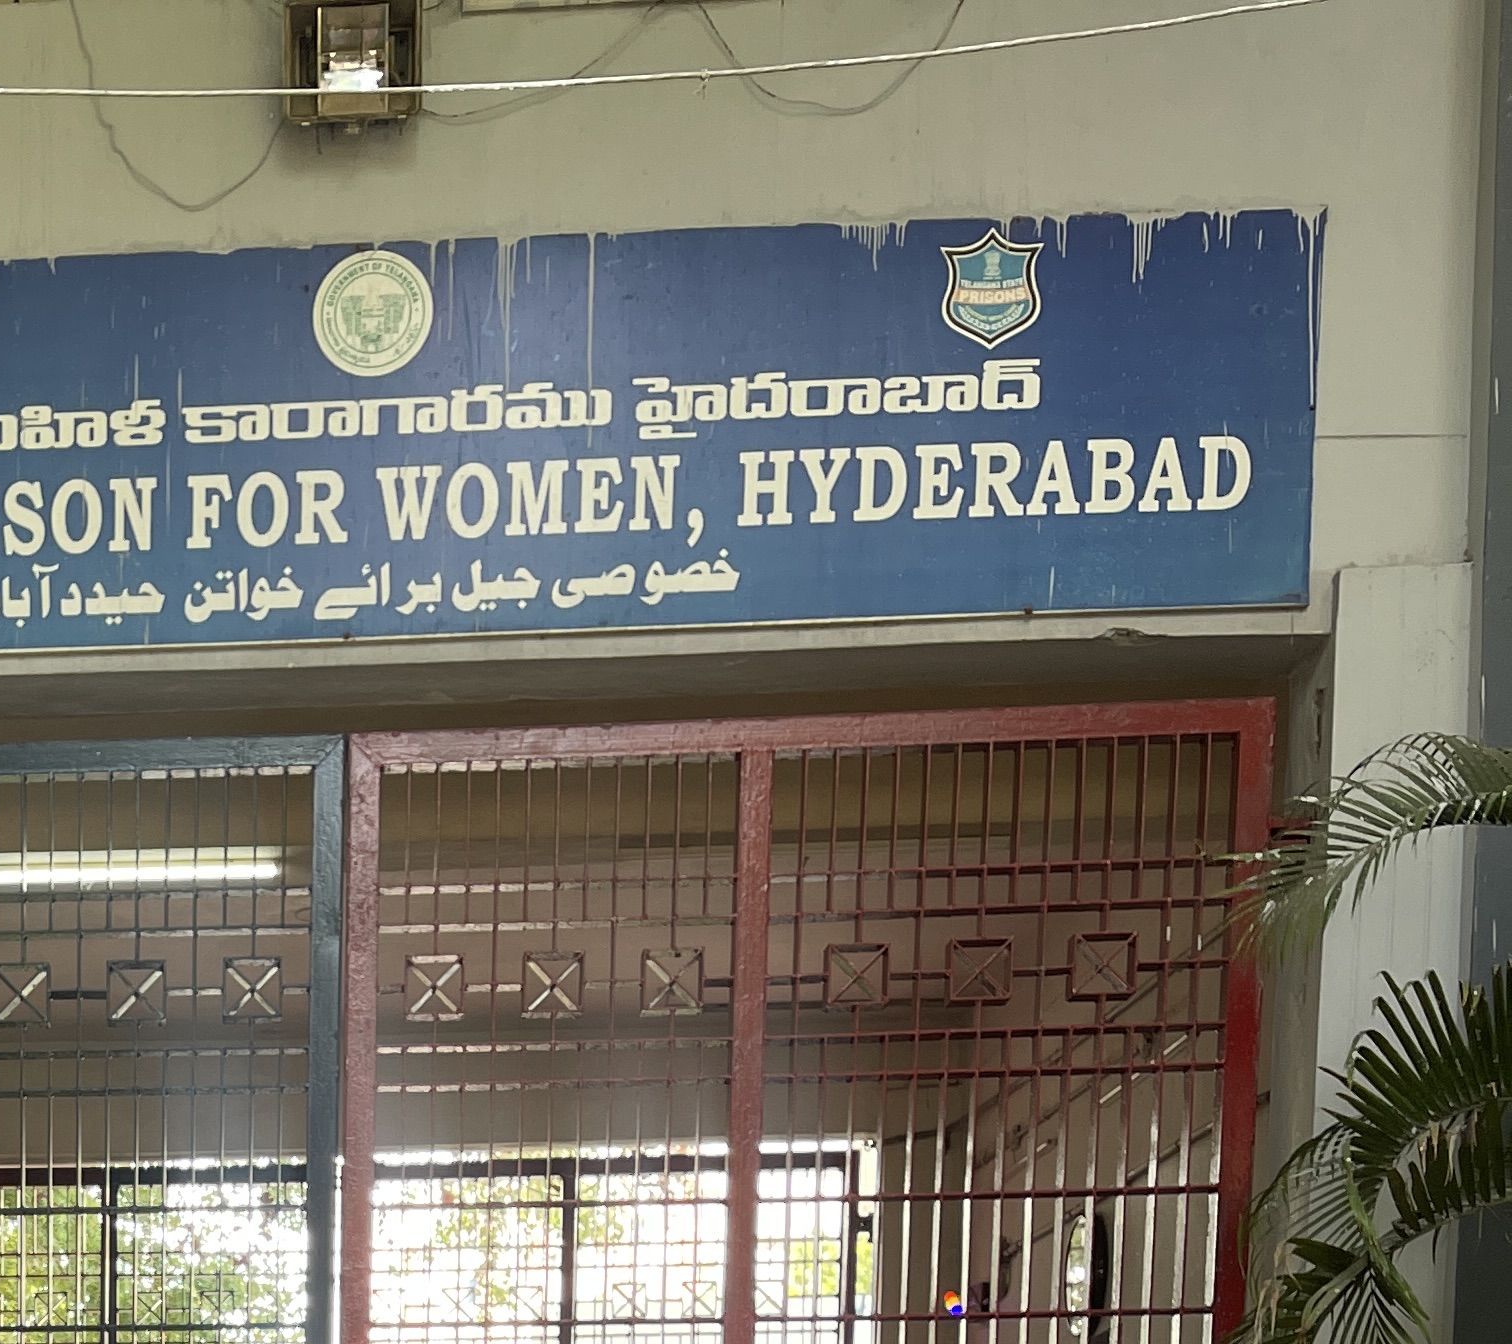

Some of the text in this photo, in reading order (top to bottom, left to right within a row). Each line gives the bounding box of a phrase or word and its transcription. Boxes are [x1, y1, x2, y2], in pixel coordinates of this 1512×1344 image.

[326, 262, 370, 307] GOVERNMENT
[371, 262, 383, 271] OF
[958, 288, 1027, 303] PRISONS
[181, 381, 614, 444] కారాగారము
[631, 357, 1043, 441] హైదరాబాద్
[185, 470, 349, 549] FOR
[374, 452, 705, 549] WOMEN,
[736, 435, 1252, 527] HYDERABAD
